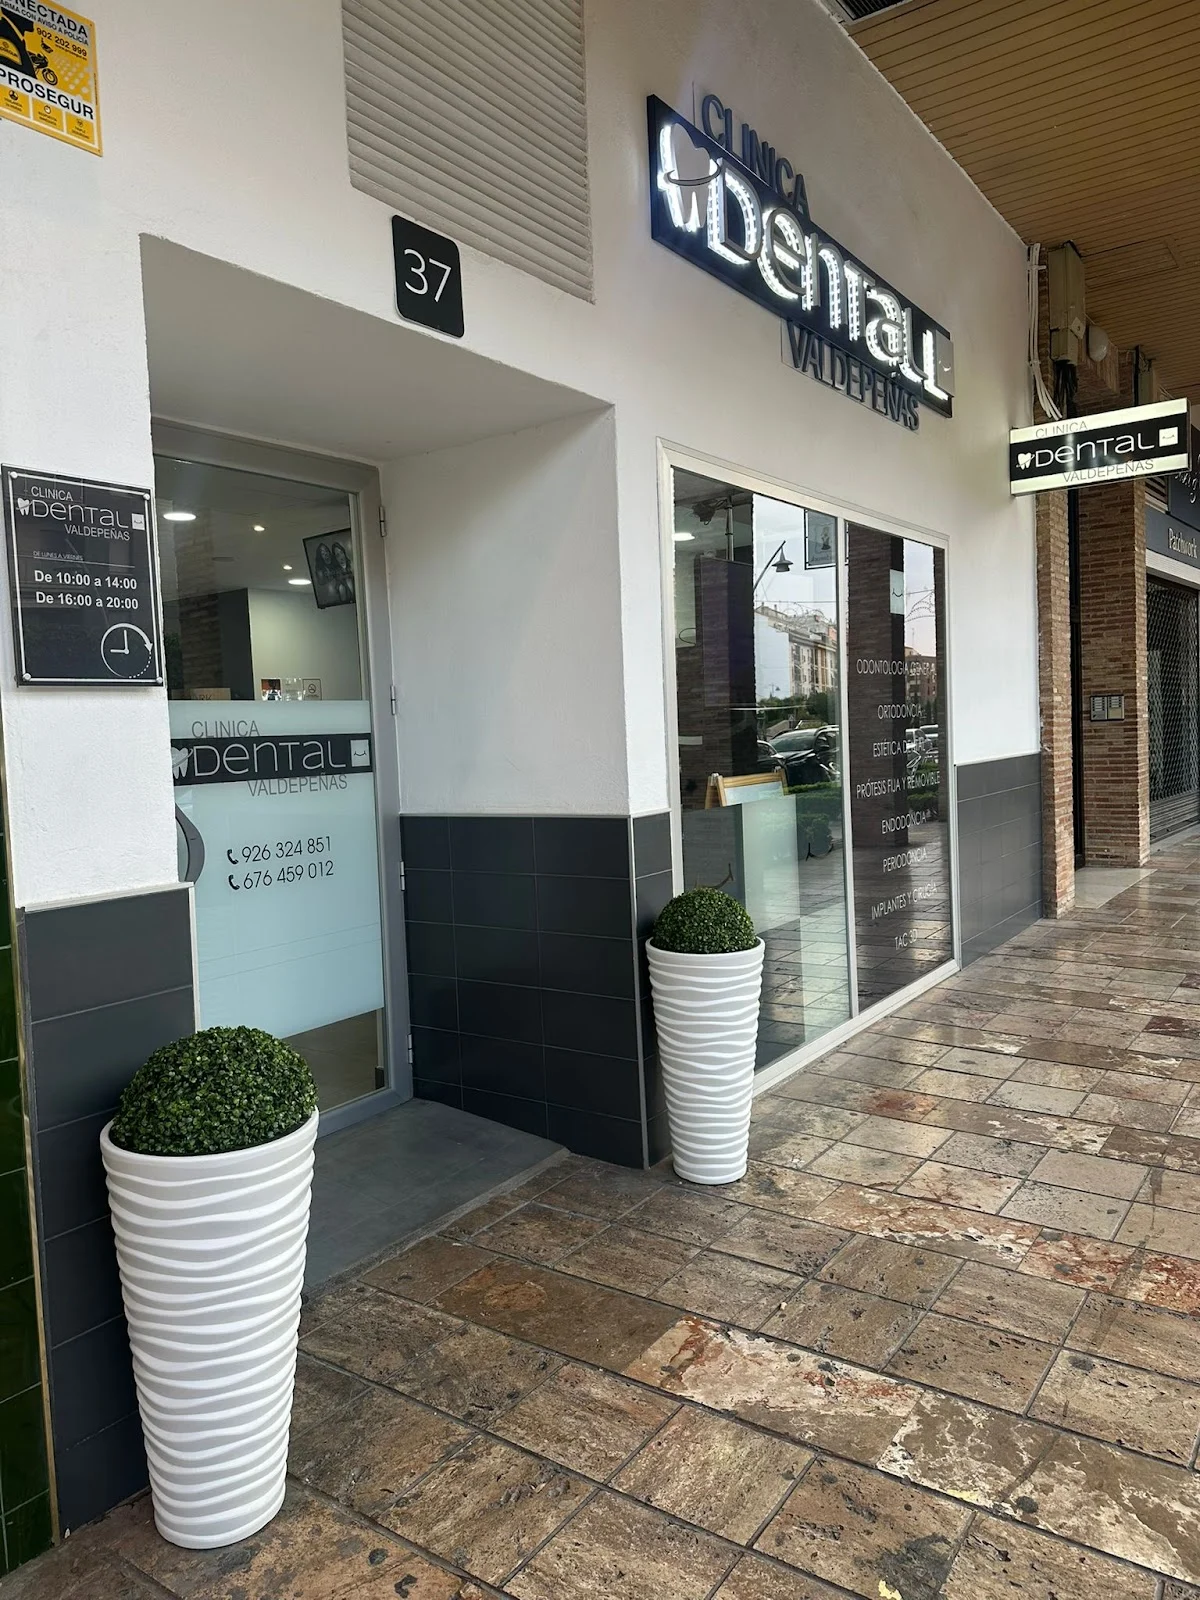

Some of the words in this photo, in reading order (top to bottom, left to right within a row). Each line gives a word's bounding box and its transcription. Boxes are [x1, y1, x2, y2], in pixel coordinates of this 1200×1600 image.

[8, 0, 88, 38] NECTADA
[36, 27, 52, 40] 902
[55, 36, 70, 49] 202
[72, 43, 87, 57] 999
[404, 248, 452, 302] 37
[1035, 420, 1088, 439] CLINICA
[31, 486, 74, 502] CLINICA
[64, 523, 130, 541] VALDEPEÑAS
[1168, 527, 1198, 559] Patchwork
[34, 570, 52, 583] De
[56, 573, 91, 587] 10:00
[94, 578, 102, 587] a
[105, 576, 138, 590] 14:00
[36, 591, 54, 605] De
[58, 594, 92, 607] 16:00
[95, 598, 103, 607] a
[106, 596, 139, 610] 20:00
[877, 704, 922, 720] ORTODONCIA
[192, 720, 261, 739] CLINICA
[246, 772, 348, 797] VALDEPEÑAS
[856, 778, 886, 799] PRÓTESIS
[888, 778, 901, 793] FIJA
[881, 811, 927, 835] ENDODONCIA
[242, 844, 271, 863] 926
[275, 840, 302, 859] 324
[307, 836, 332, 854] 851
[882, 847, 928, 873] PERIODONCIA
[243, 870, 273, 890] 676
[277, 865, 304, 884] 459
[308, 860, 334, 879] 012
[871, 894, 907, 920] IMPLANTES
[895, 935, 908, 951] TAC
[909, 929, 918, 944] 3D
